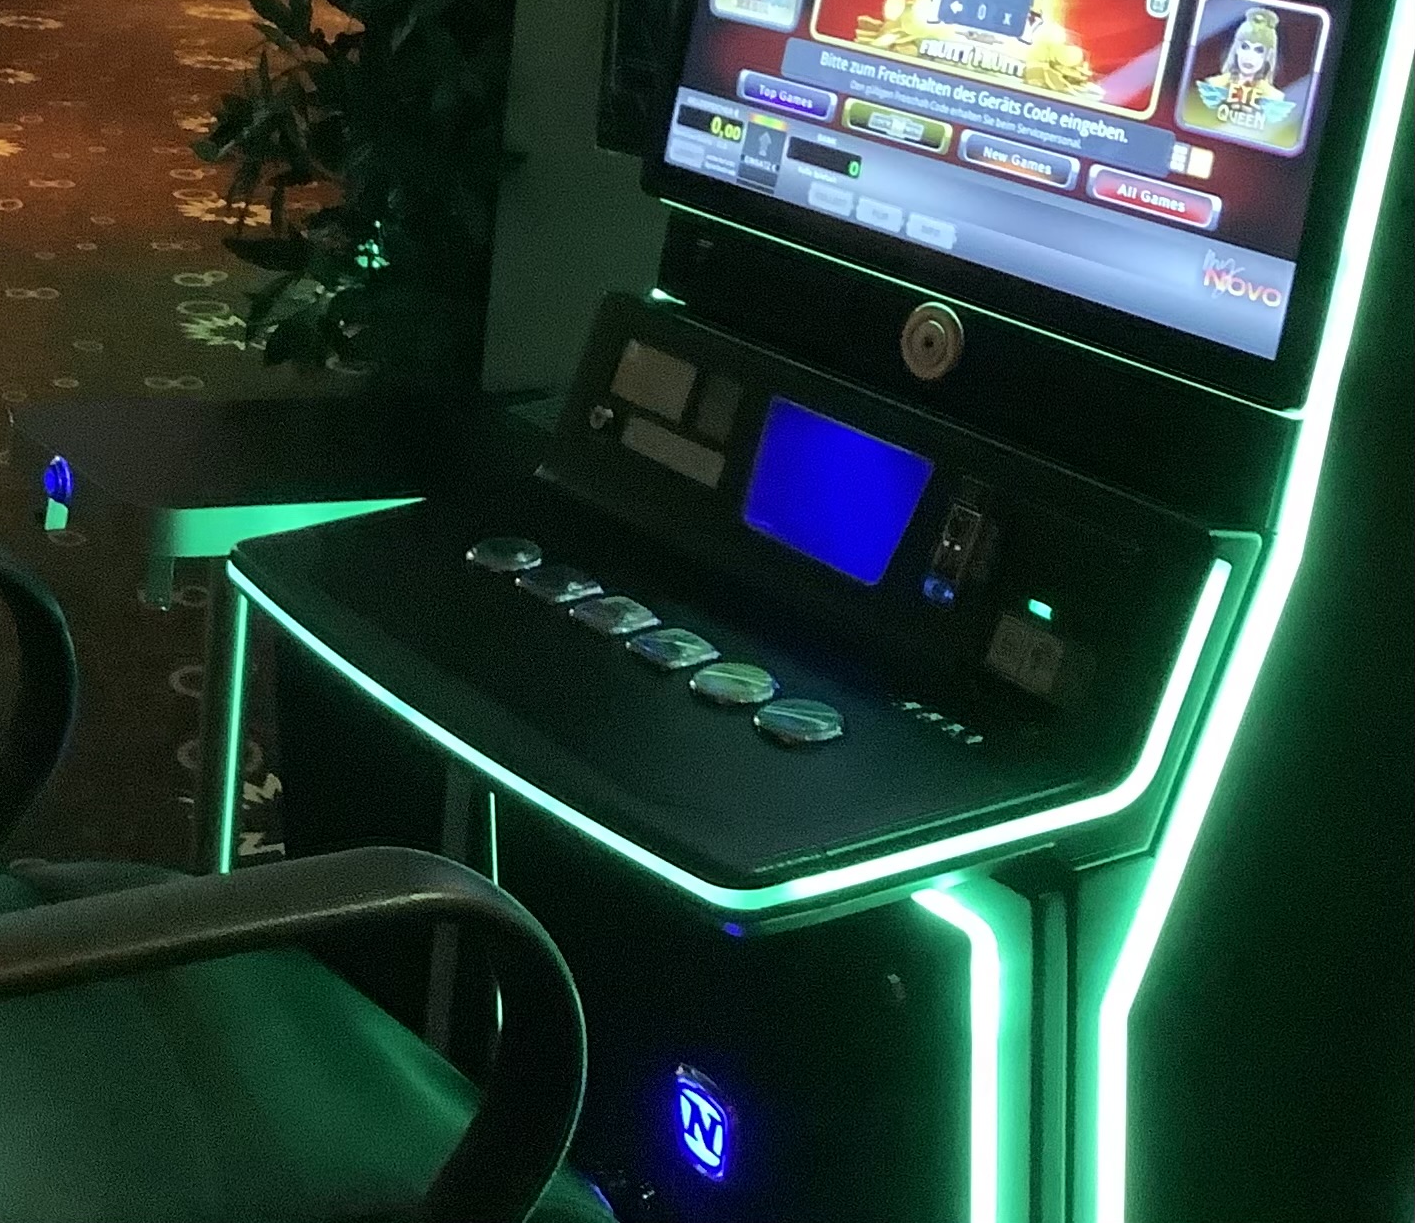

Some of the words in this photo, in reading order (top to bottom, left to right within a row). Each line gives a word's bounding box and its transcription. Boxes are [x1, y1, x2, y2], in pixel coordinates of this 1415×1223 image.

[977, 4, 987, 21] 0
[758, 84, 776, 99] Top
[779, 90, 814, 109] Games
[820, 51, 849, 71] Bitte
[850, 61, 876, 78] zum
[878, 65, 951, 98] Freischalten
[952, 84, 977, 105] des
[979, 90, 1022, 116] Geräts
[1023, 101, 1058, 124] Code
[1059, 109, 1129, 143] eingeben.
[1227, 82, 1263, 110] EYE
[710, 115, 742, 141] 0,00
[1217, 103, 1266, 130] QUEEN
[848, 160, 860, 177] 0
[982, 145, 1007, 163] New
[1011, 153, 1052, 176] Games
[1117, 182, 1137, 199] All
[1140, 186, 1186, 213] Games
[1203, 268, 1282, 308] NOVO
